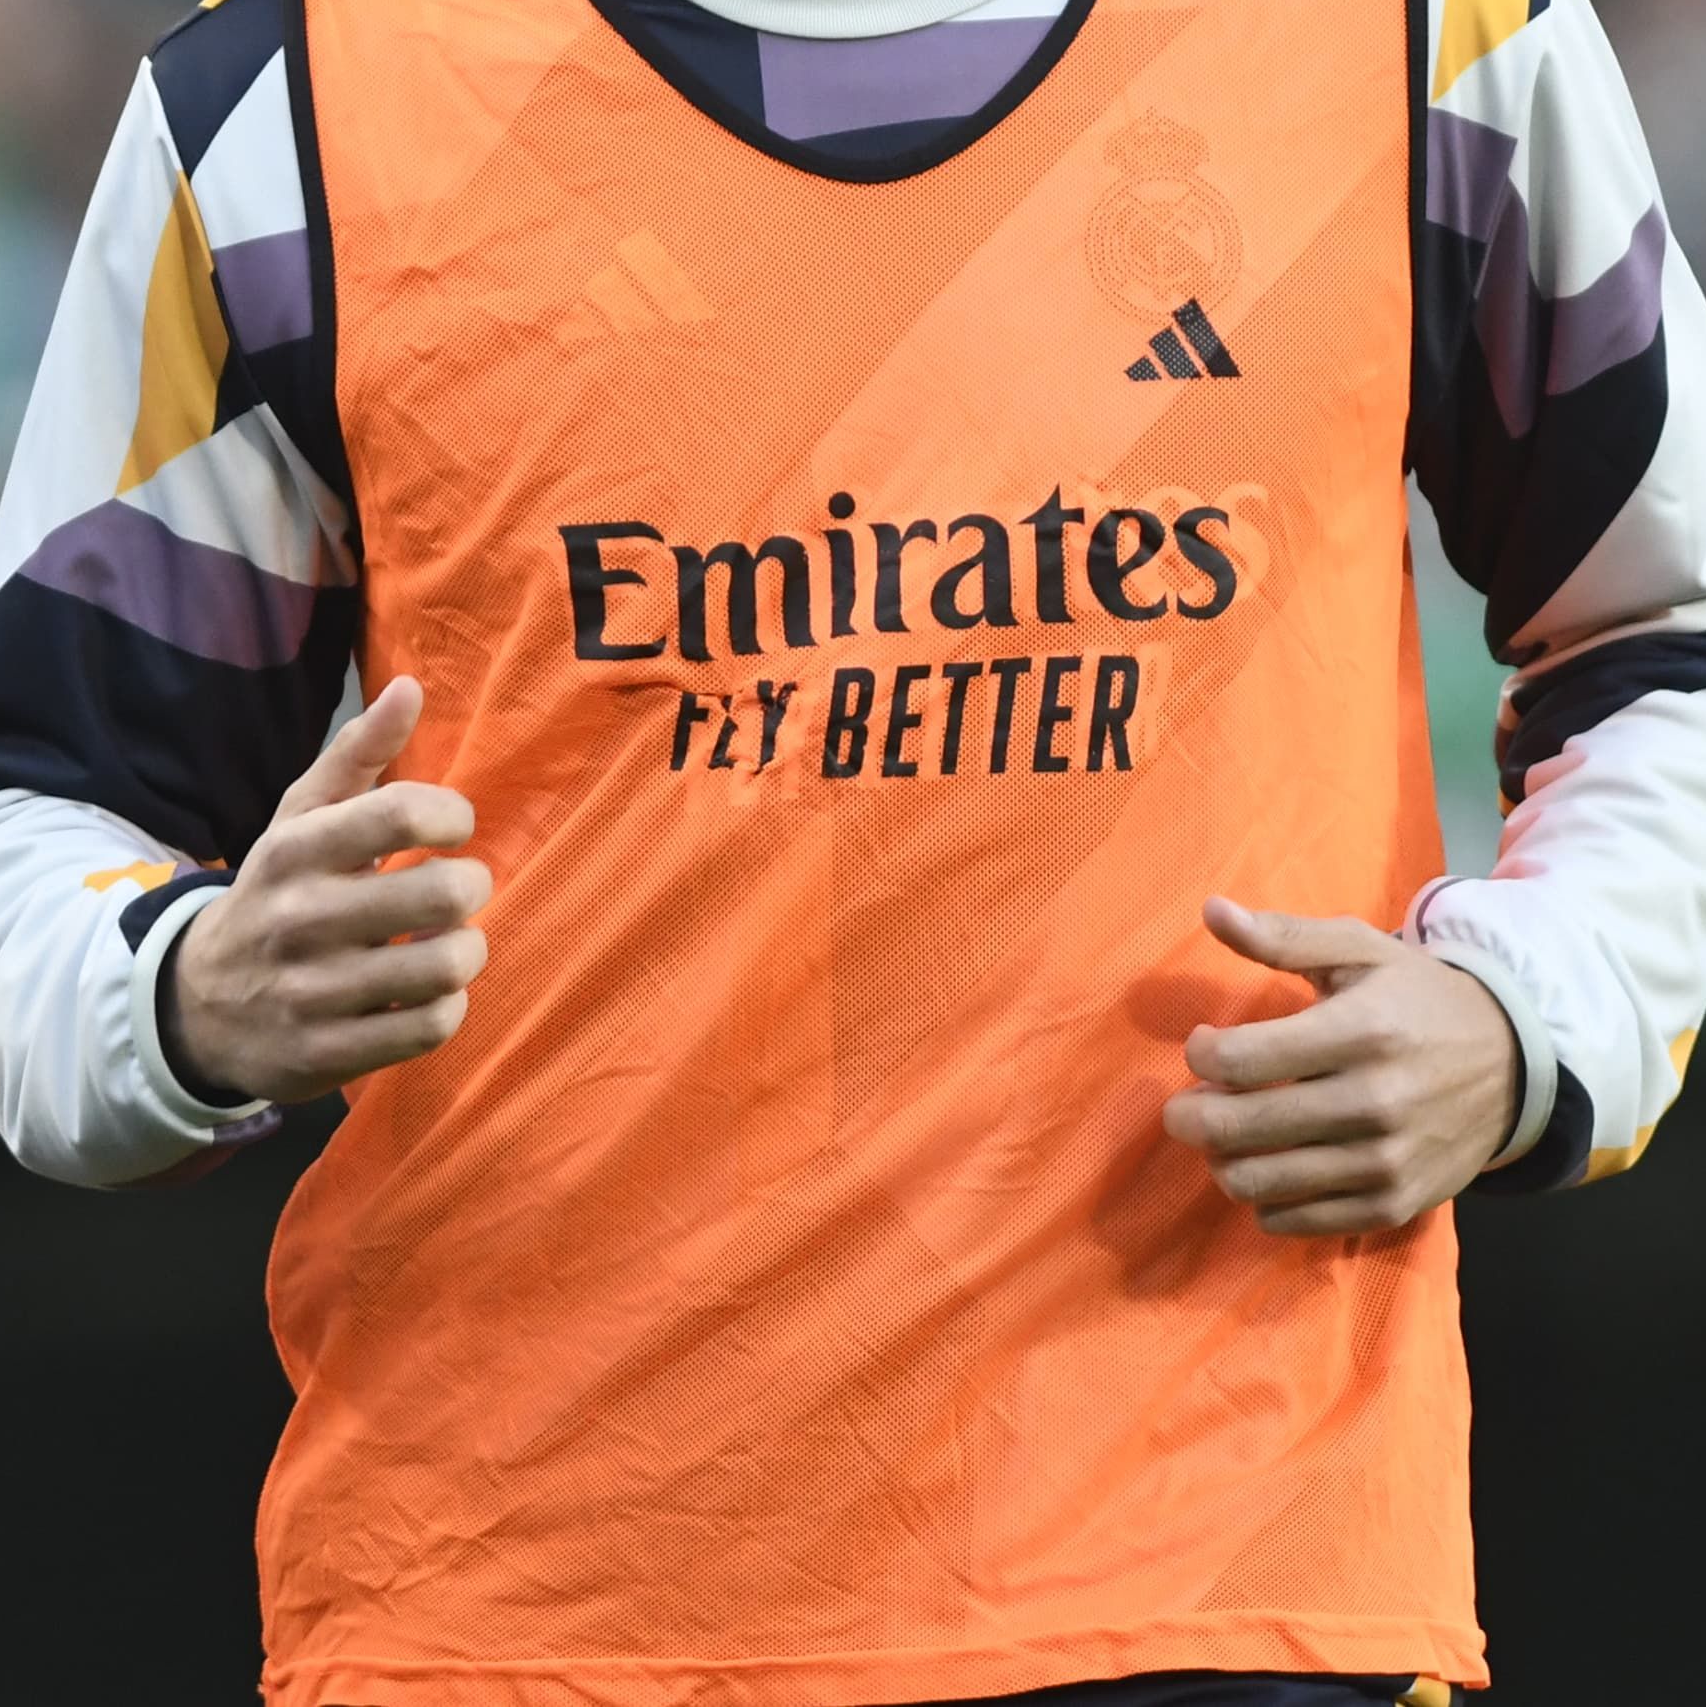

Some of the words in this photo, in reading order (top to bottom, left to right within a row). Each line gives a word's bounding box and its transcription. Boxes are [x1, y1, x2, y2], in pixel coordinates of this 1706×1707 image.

[557, 484, 1237, 664] Emirates
[669, 679, 799, 776] FLY
[821, 655, 1140, 780] BETTER
